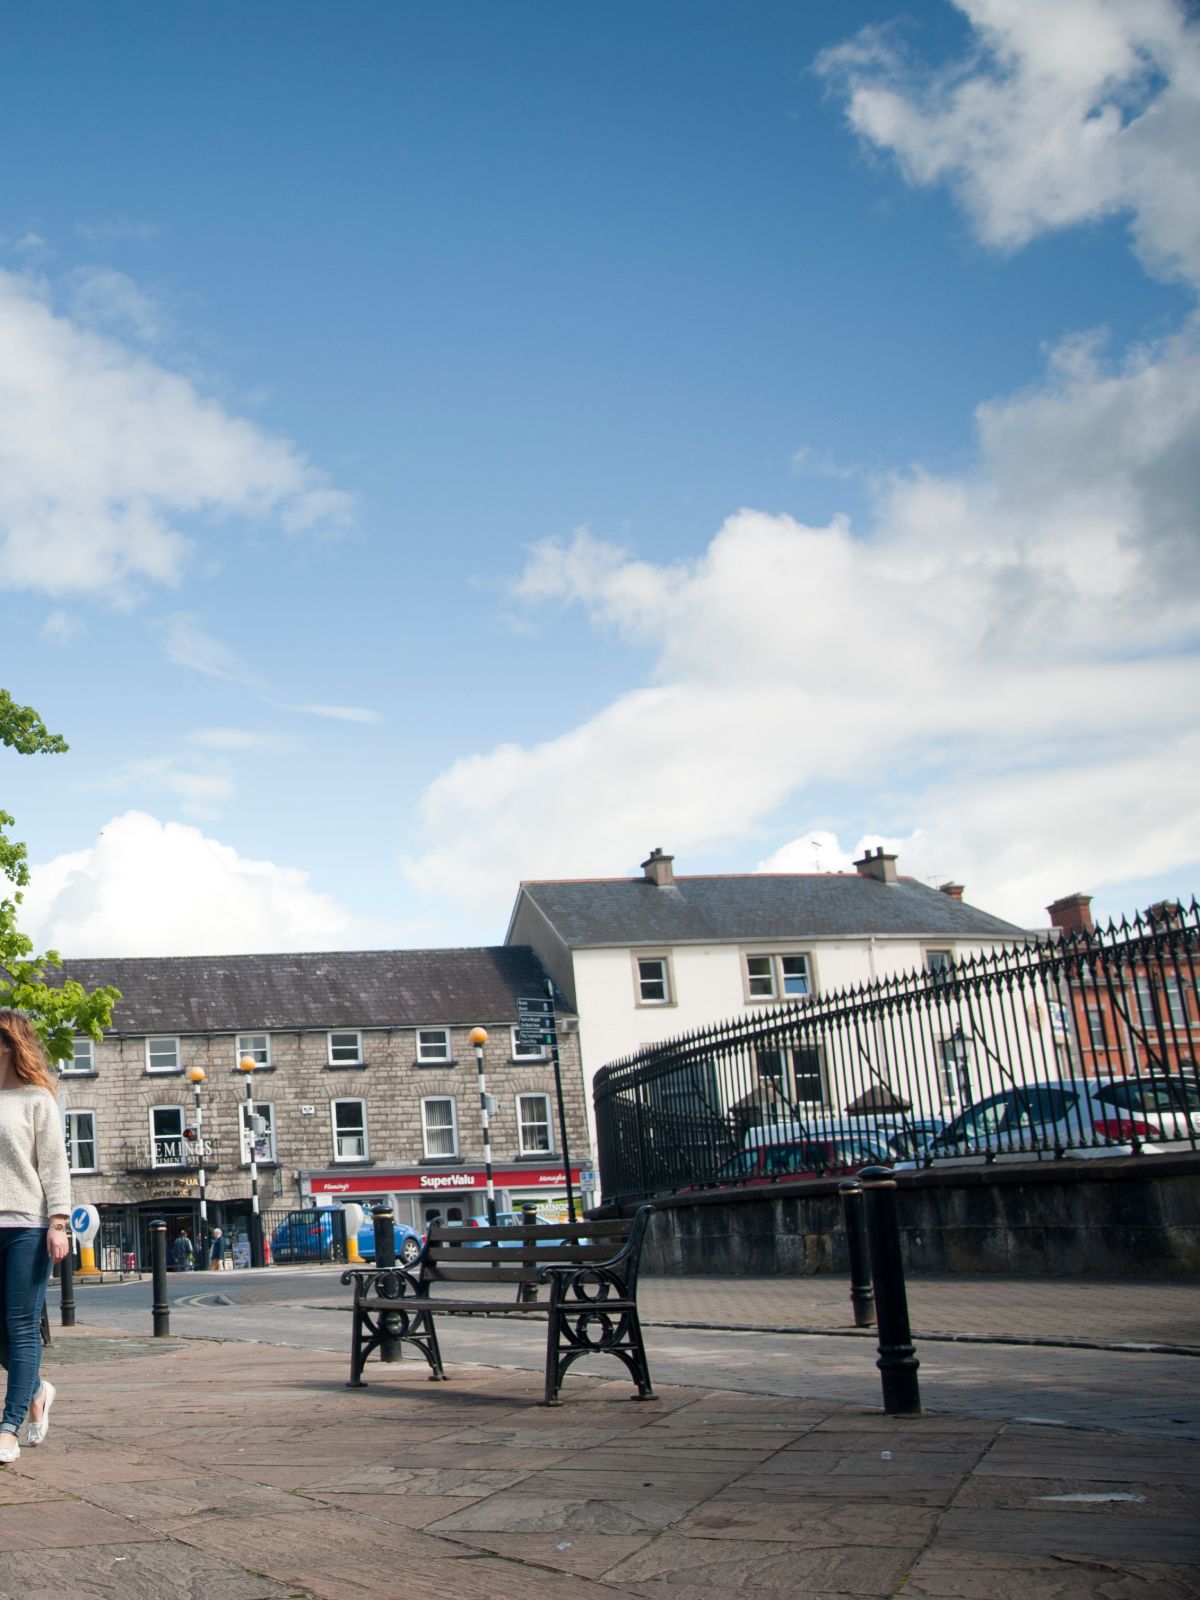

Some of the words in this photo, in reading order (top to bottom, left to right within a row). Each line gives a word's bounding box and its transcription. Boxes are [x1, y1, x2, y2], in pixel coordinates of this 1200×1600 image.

[135, 1140, 212, 1158] FLEMINGS
[420, 1174, 475, 1188] SuperValu
[539, 1174, 567, 1184] Monagha
